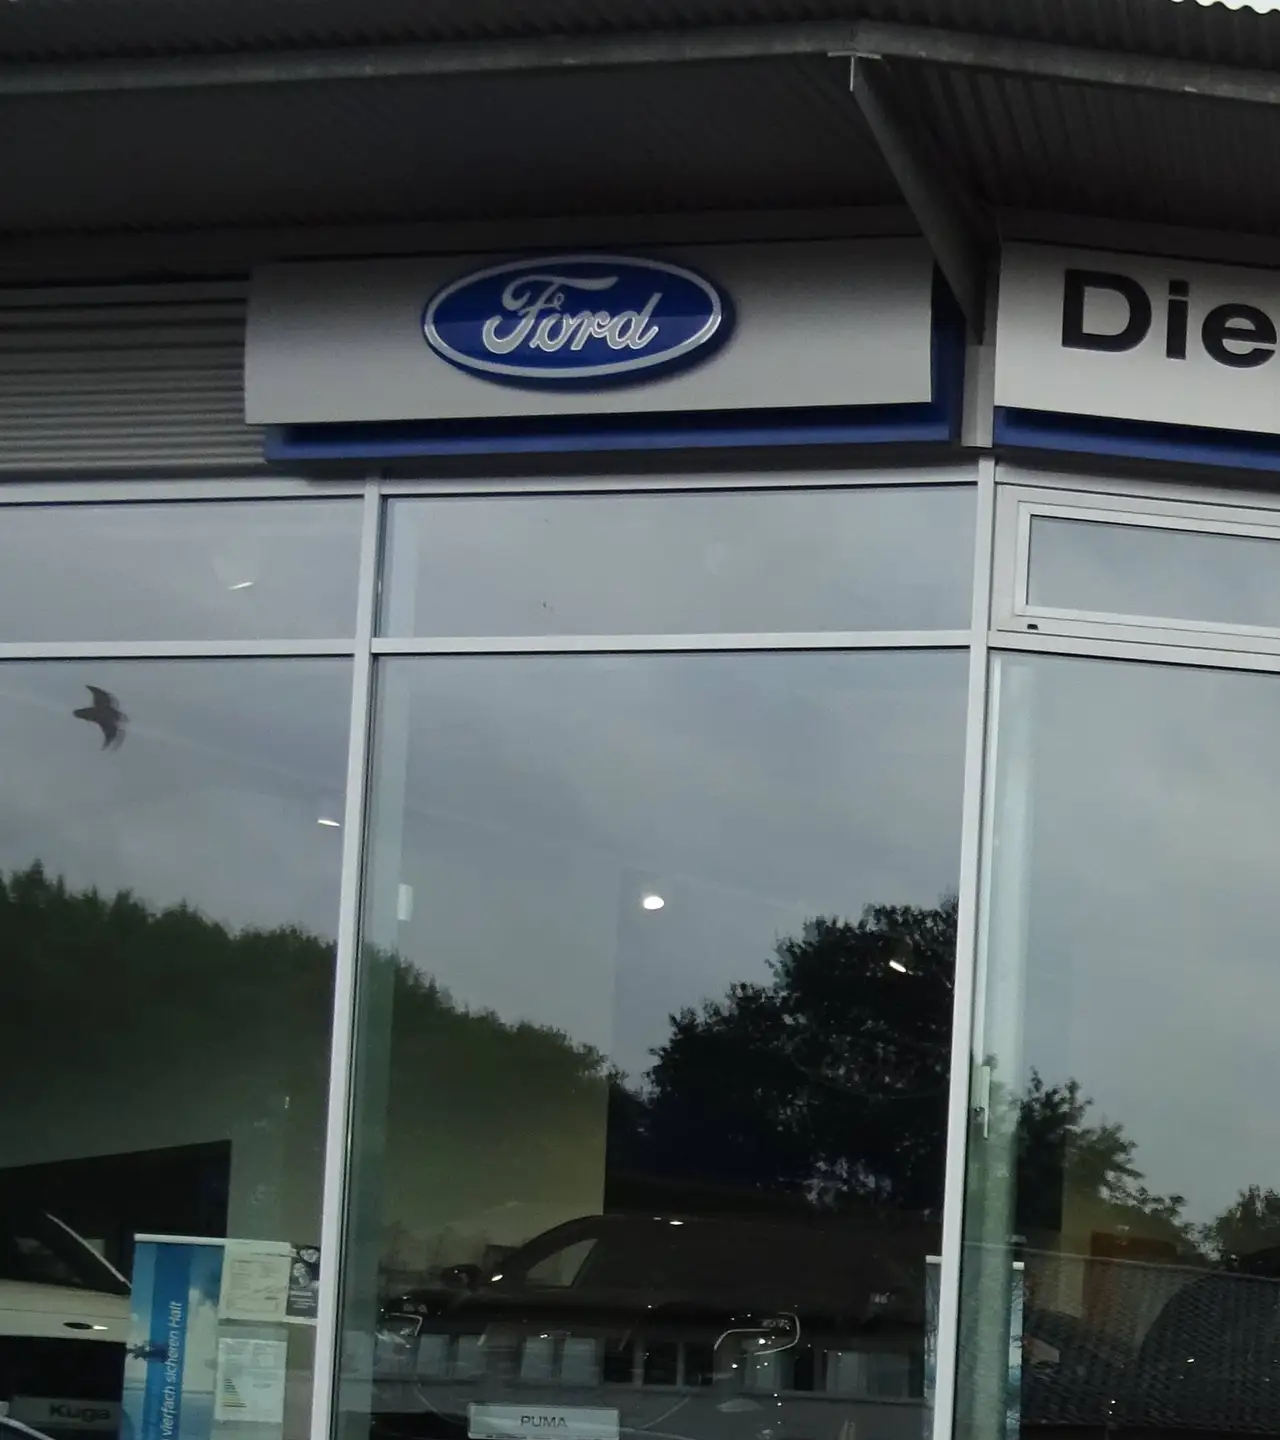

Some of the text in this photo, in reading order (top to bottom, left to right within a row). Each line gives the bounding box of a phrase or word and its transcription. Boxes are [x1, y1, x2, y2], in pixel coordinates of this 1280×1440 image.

[482, 276, 660, 355] Ford
[164, 1330, 180, 1383] sicheren
[49, 1402, 111, 1423] Kuga
[160, 1384, 178, 1435] vierfach
[520, 1415, 568, 1429] PUMA
